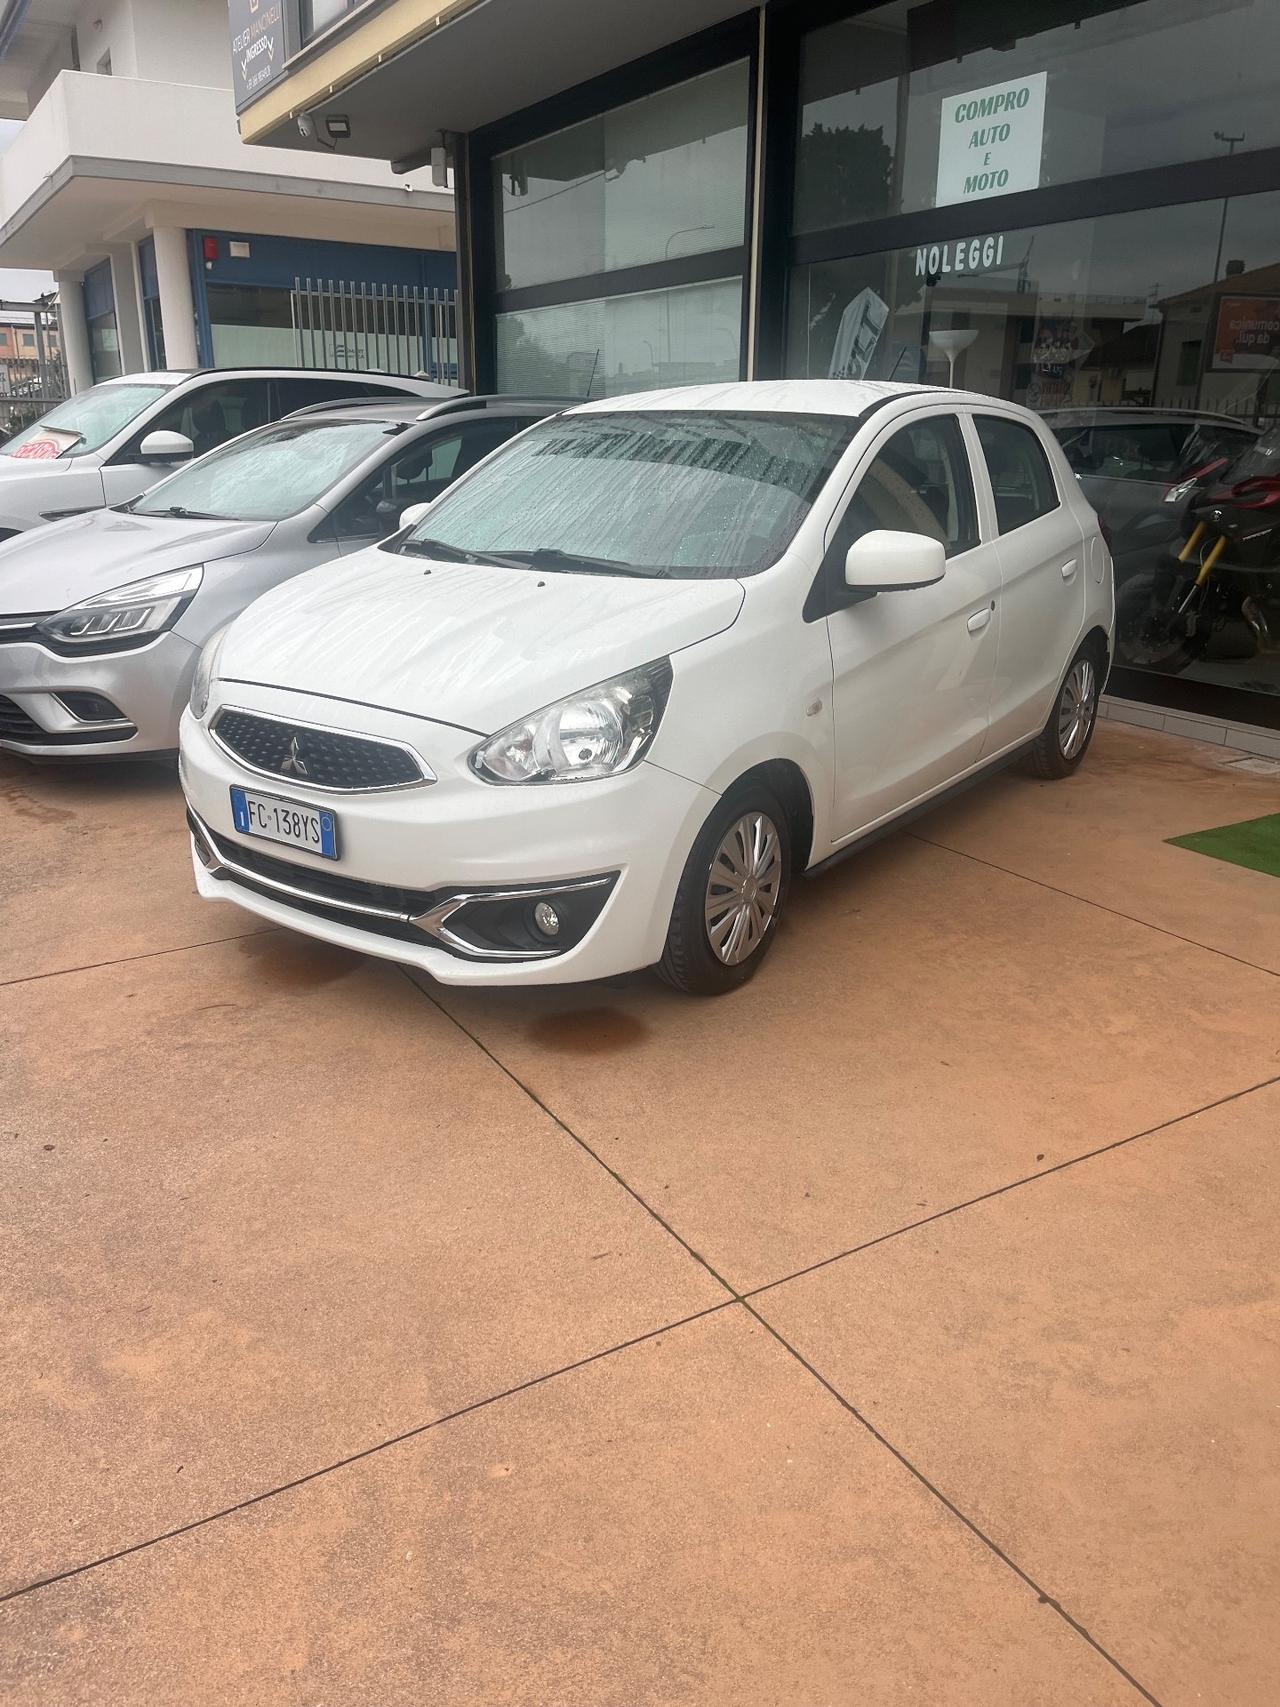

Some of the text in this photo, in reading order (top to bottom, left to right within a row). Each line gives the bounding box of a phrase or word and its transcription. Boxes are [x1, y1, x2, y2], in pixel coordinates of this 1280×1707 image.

[233, 28, 251, 55] ATELIER
[246, 35, 268, 62] INGRESSO
[954, 87, 1030, 123] COMPRO
[968, 123, 1011, 149] AUTO
[983, 152, 992, 166] E
[963, 168, 1009, 194] MOTO
[915, 235, 1004, 277] NOLEGGI
